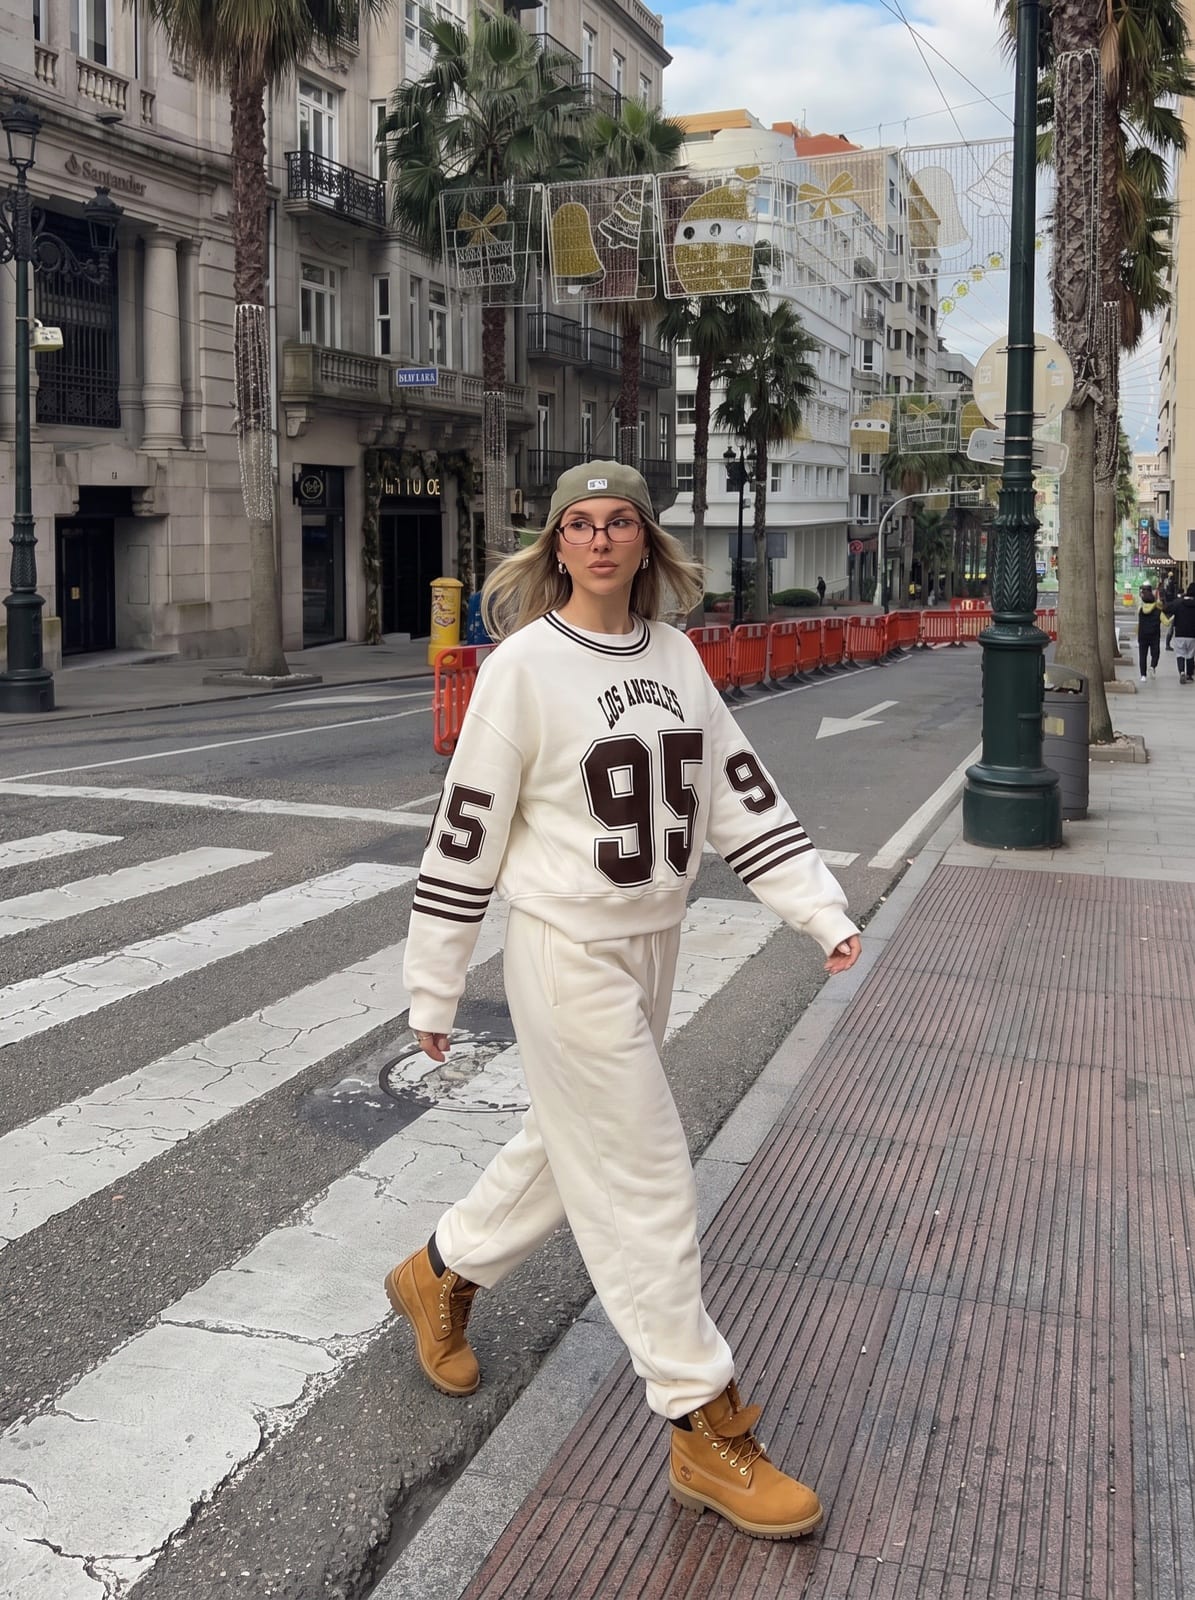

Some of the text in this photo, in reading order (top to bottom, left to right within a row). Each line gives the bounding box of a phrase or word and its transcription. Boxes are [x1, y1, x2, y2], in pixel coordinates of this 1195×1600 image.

[82, 160, 148, 197] Santander
[597, 678, 685, 730] LOS ANGELES
[580, 728, 703, 888] 95
[723, 748, 779, 816] 9
[426, 782, 495, 864] 5
